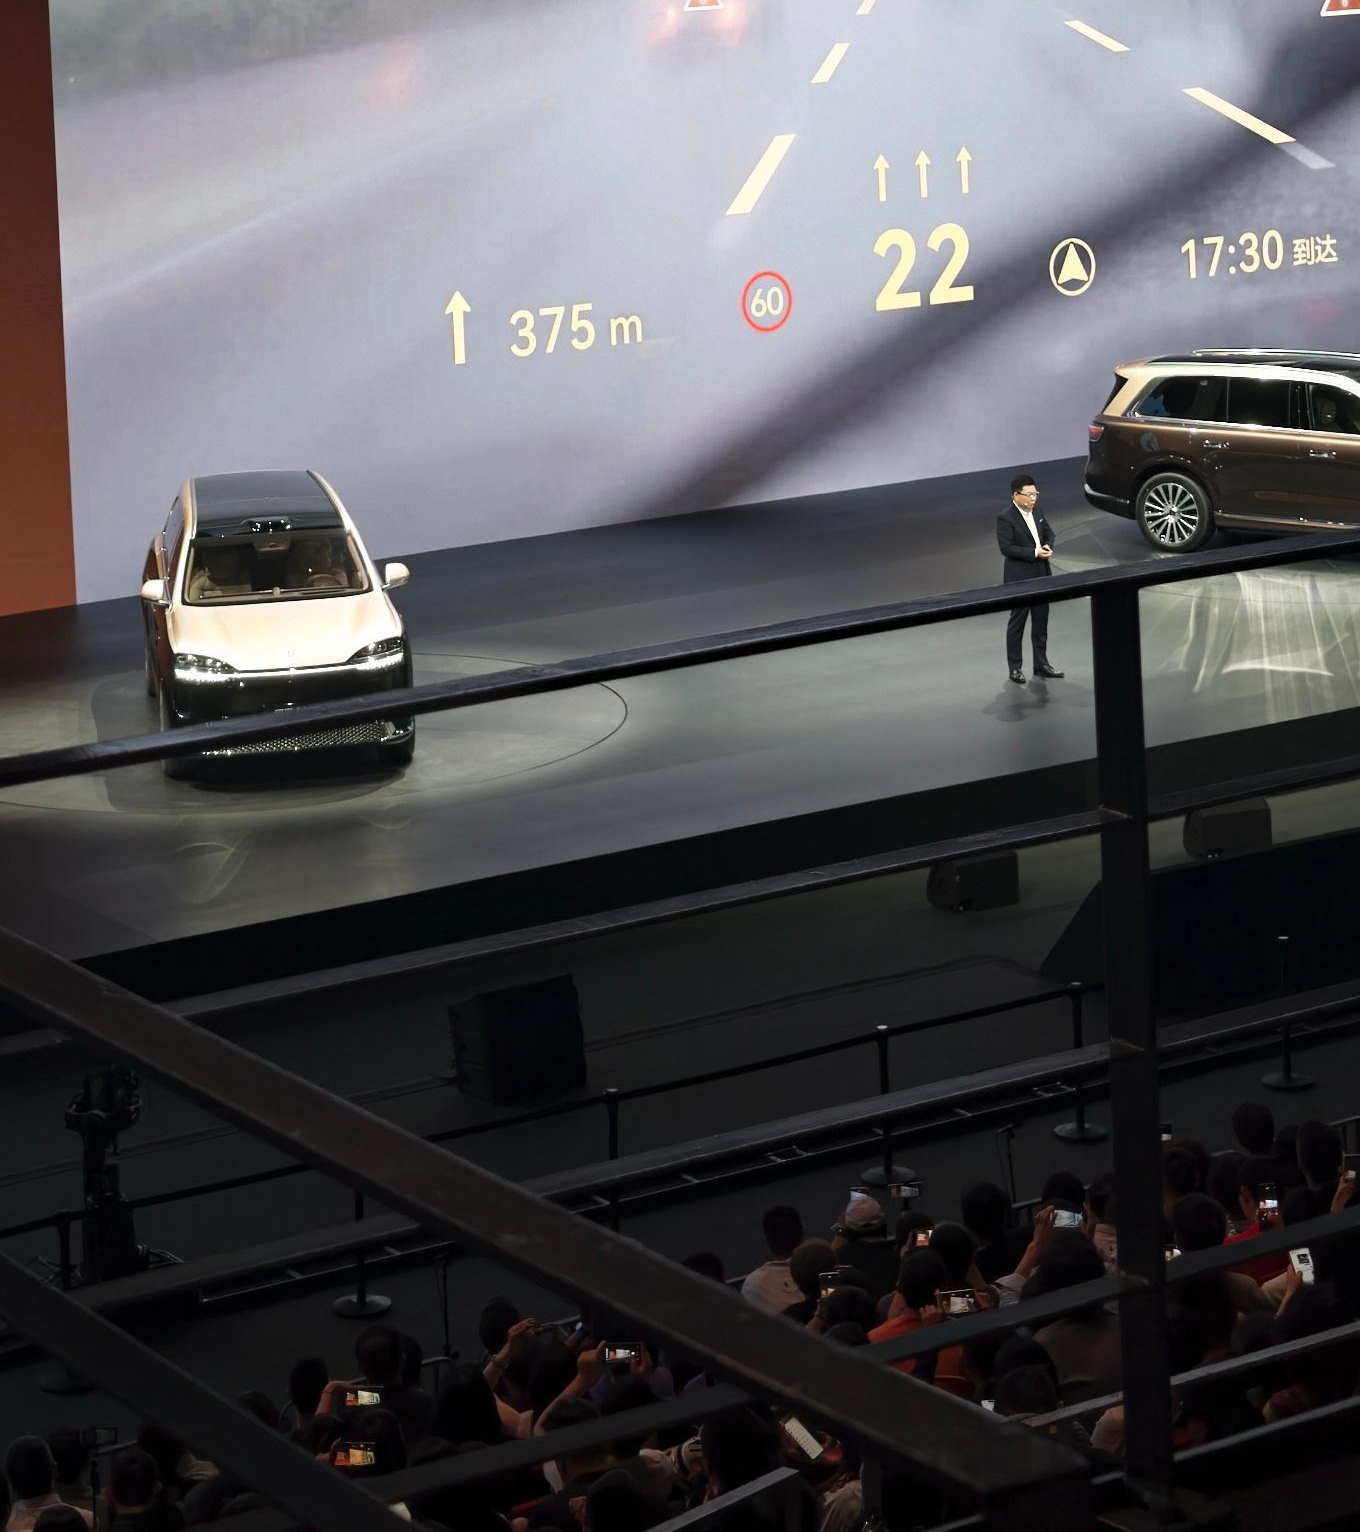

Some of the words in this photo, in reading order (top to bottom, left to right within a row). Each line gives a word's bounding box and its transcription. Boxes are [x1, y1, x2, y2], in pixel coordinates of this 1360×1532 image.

[873, 222, 974, 312] 22
[1181, 229, 1284, 279] 17:30
[1292, 234, 1338, 266] 到达
[750, 286, 784, 317] 60
[509, 302, 596, 357] 375
[609, 315, 643, 346] m
